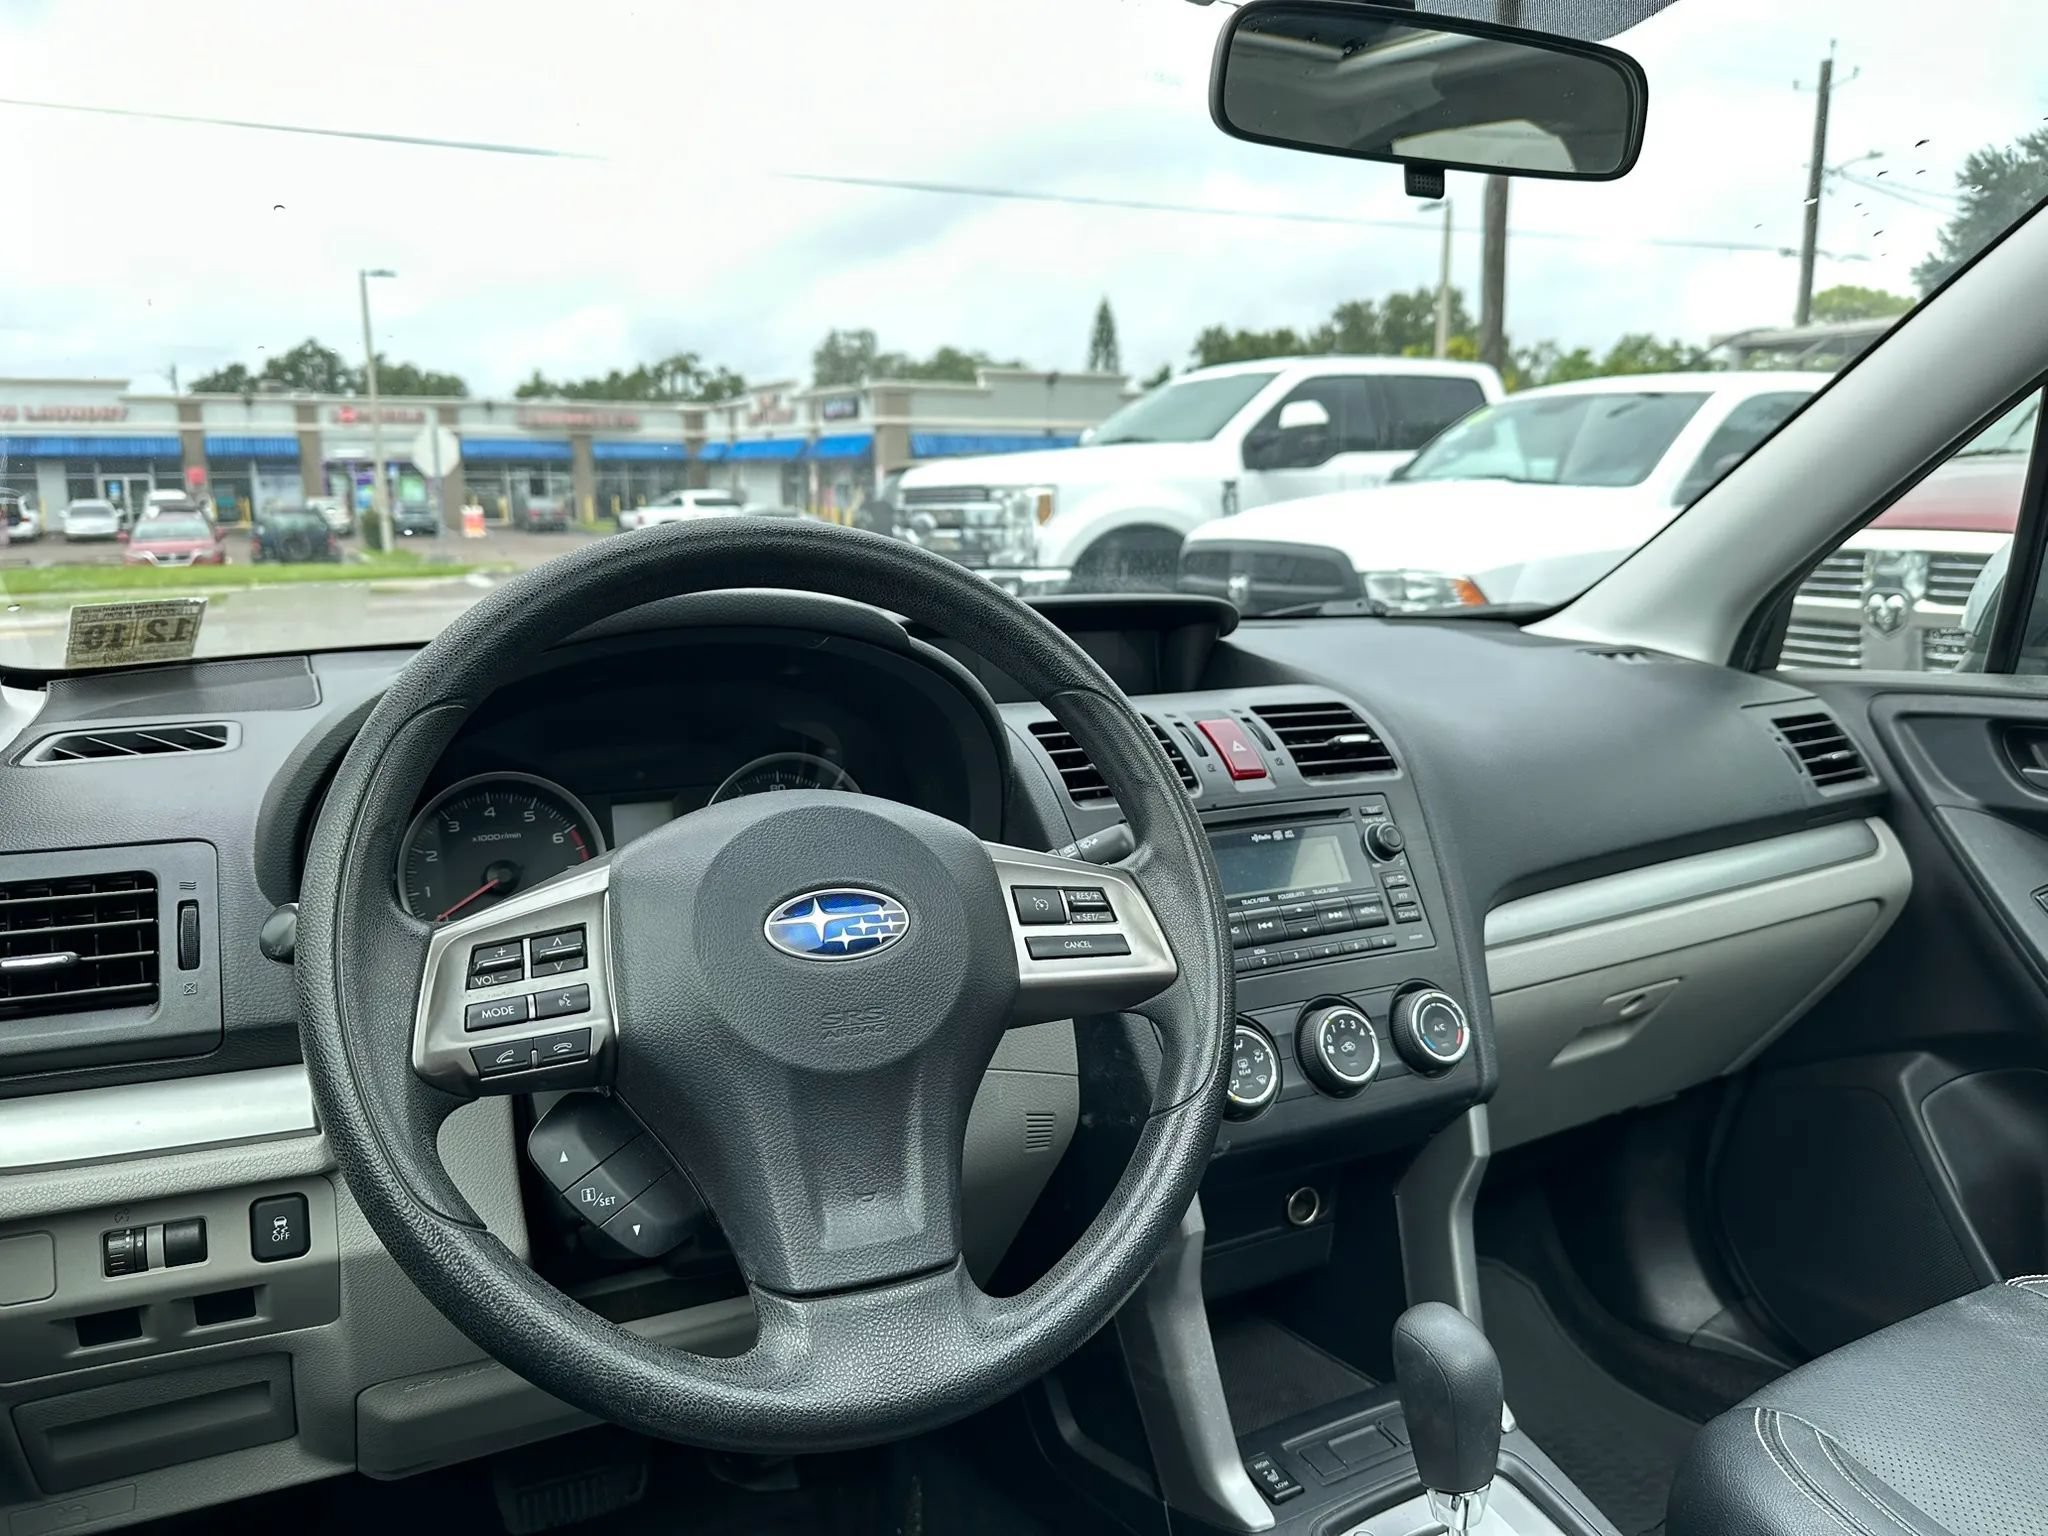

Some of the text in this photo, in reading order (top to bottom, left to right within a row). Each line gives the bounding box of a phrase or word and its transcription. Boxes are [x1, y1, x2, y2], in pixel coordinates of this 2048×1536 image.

[484, 807, 496, 817] 4
[524, 811, 535, 822] 5
[448, 821, 460, 832] 3
[553, 833, 565, 843] 6
[426, 851, 438, 862] 2
[424, 886, 431, 898] 1
[1064, 940, 1092, 949] CANCEL
[475, 975, 497, 985] VOL
[481, 1005, 515, 1019] MODE
[821, 1007, 886, 1027] SRS
[1331, 1024, 1336, 1032] 1
[1339, 1019, 1345, 1028] 2
[1350, 1020, 1356, 1029] 3
[822, 1023, 888, 1040] AIRBAG
[272, 1232, 290, 1241] OFF
[1274, 1480, 1289, 1489] LOW
